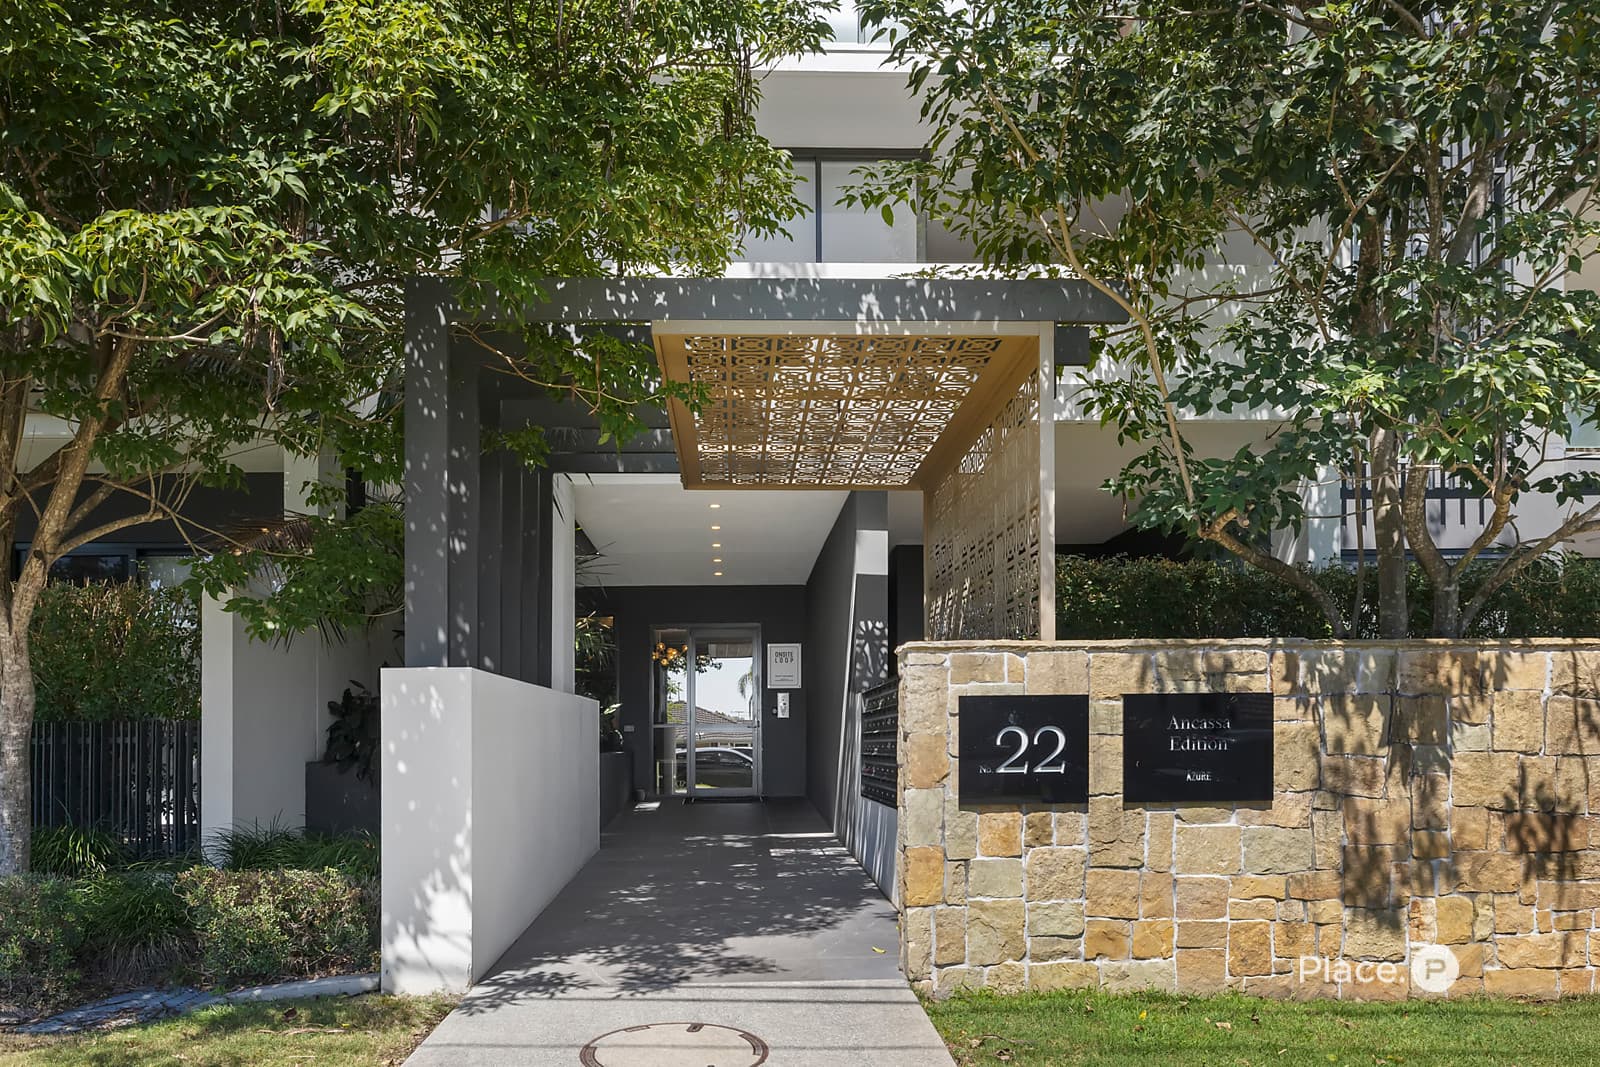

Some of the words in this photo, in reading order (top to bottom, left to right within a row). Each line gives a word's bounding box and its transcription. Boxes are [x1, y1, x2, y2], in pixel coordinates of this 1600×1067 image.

[1167, 716, 1231, 731] Ancassa
[995, 725, 1067, 775] 22
[1169, 735, 1229, 752] Edition
[1186, 771, 1212, 782] AZURE
